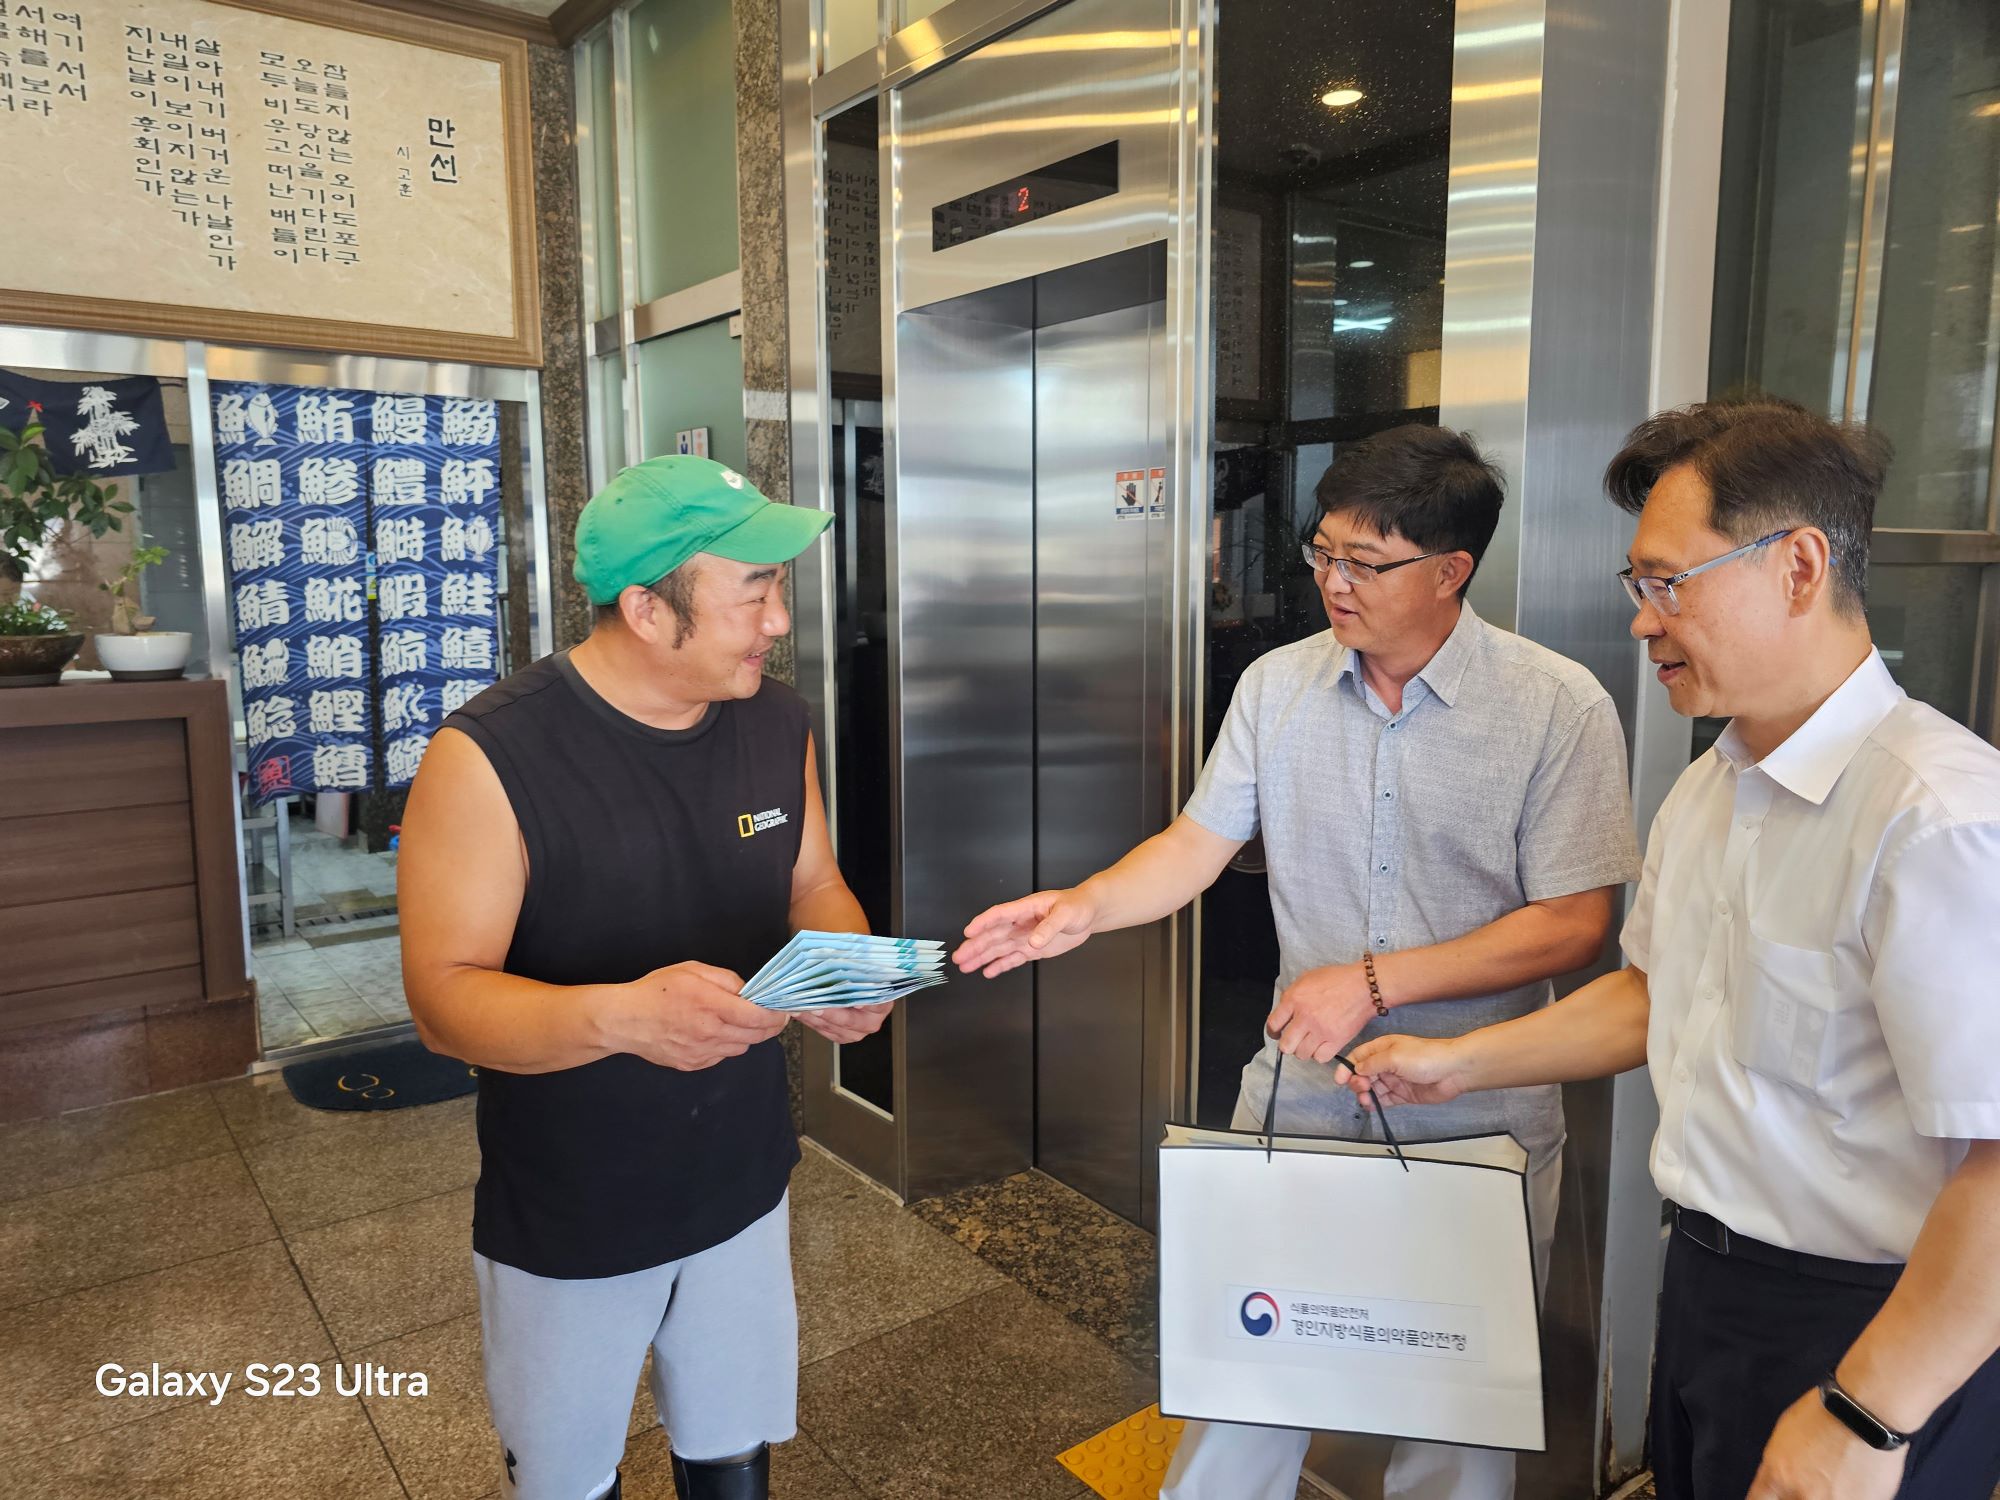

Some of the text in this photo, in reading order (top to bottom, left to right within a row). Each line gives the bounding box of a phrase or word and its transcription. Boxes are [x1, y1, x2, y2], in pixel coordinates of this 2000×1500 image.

[15, 4, 53, 117] 서해를 보라
[52, 12, 87, 102] 여기 서서
[125, 25, 165, 196] 지난날이 후회인가
[323, 63, 349, 121] 잠들지
[159, 31, 201, 227] 내일이 보이지 않는가
[194, 38, 237, 271] 살아내기 버거운 나날인가
[259, 51, 298, 264] 모두 비우고 떠난 배들이
[327, 128, 353, 165] 않는
[427, 117, 458, 184] 만선
[292, 58, 330, 263] 오늘도 당신을 기다린다
[396, 146, 413, 198] 시 고훈
[1017, 186, 1030, 212] 2
[296, 395, 355, 444] 鮪
[372, 396, 428, 445] 鰻
[223, 459, 282, 509] 鯛
[236, 580, 289, 632] 鯖
[441, 572, 494, 617] 鮭
[380, 629, 427, 679] 鯨
[313, 744, 367, 787] 鱈
[1290, 1302, 1370, 1321] 식품의약품안전처
[1290, 1319, 1467, 1351] 경인지방식품의약품안전청
